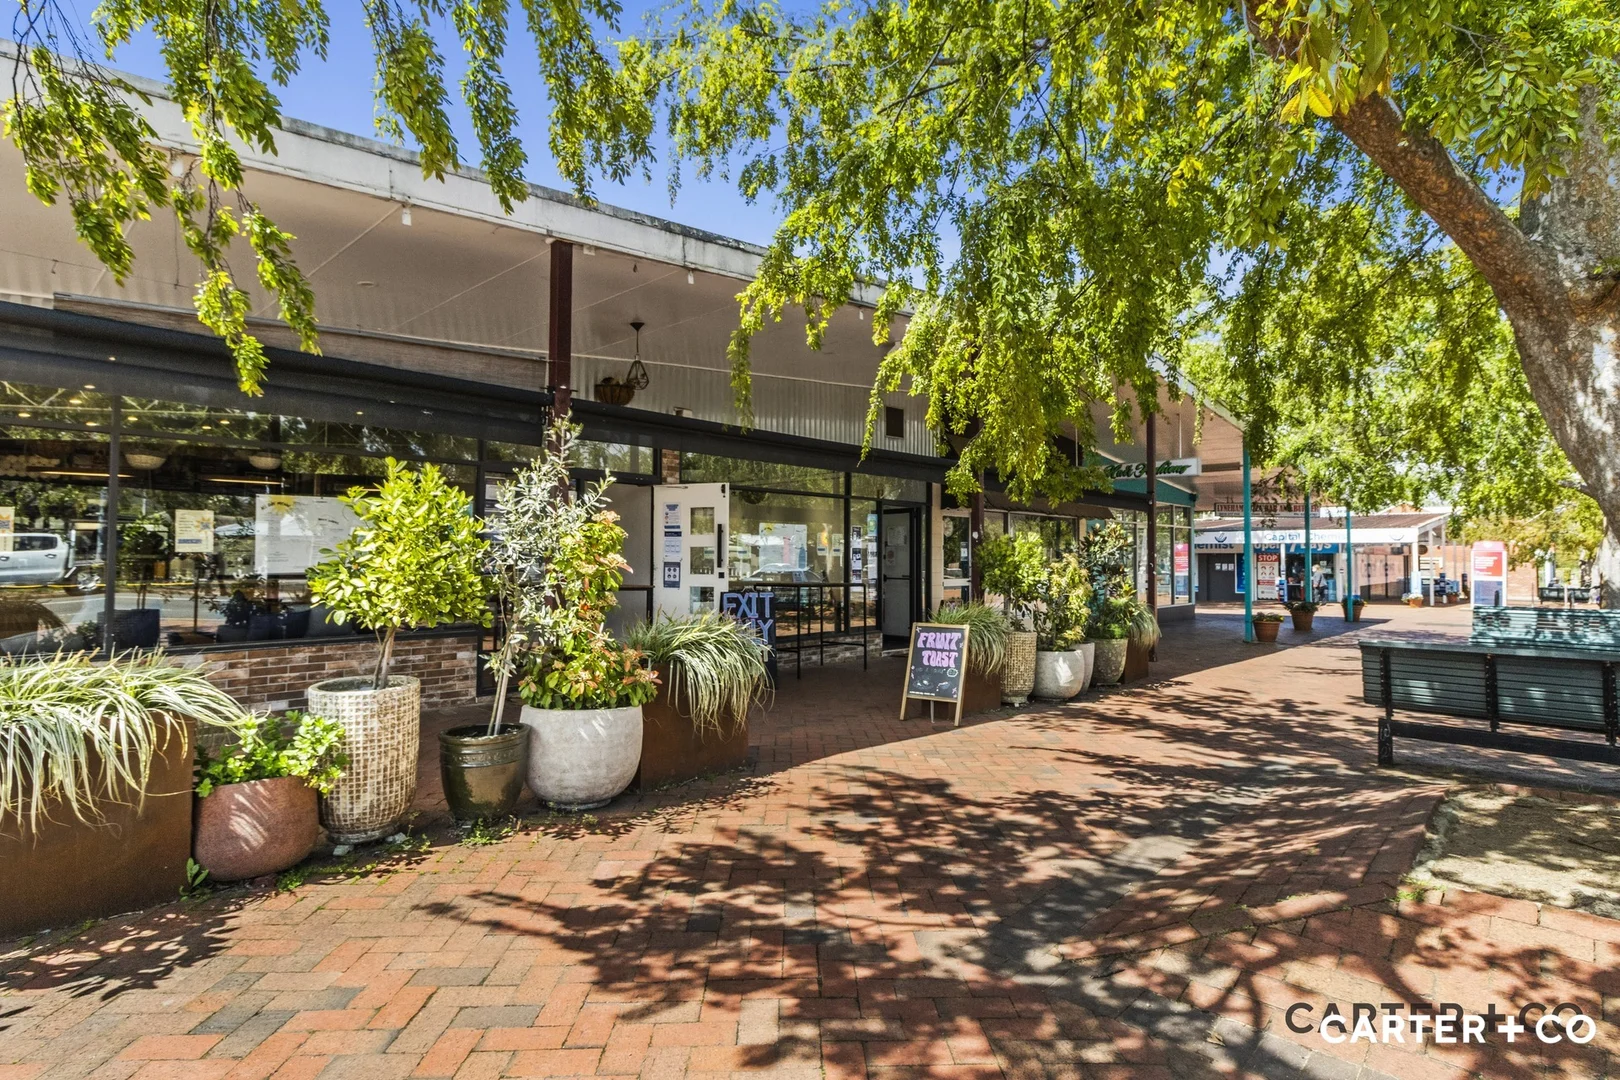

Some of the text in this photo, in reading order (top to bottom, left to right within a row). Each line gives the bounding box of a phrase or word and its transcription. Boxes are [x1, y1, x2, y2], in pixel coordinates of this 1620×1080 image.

[1265, 532, 1300, 541] Capital
[1258, 554, 1278, 562] STOP
[723, 592, 774, 618] EXIT
[917, 632, 961, 650] FRUIT
[922, 650, 958, 667] TOAST
